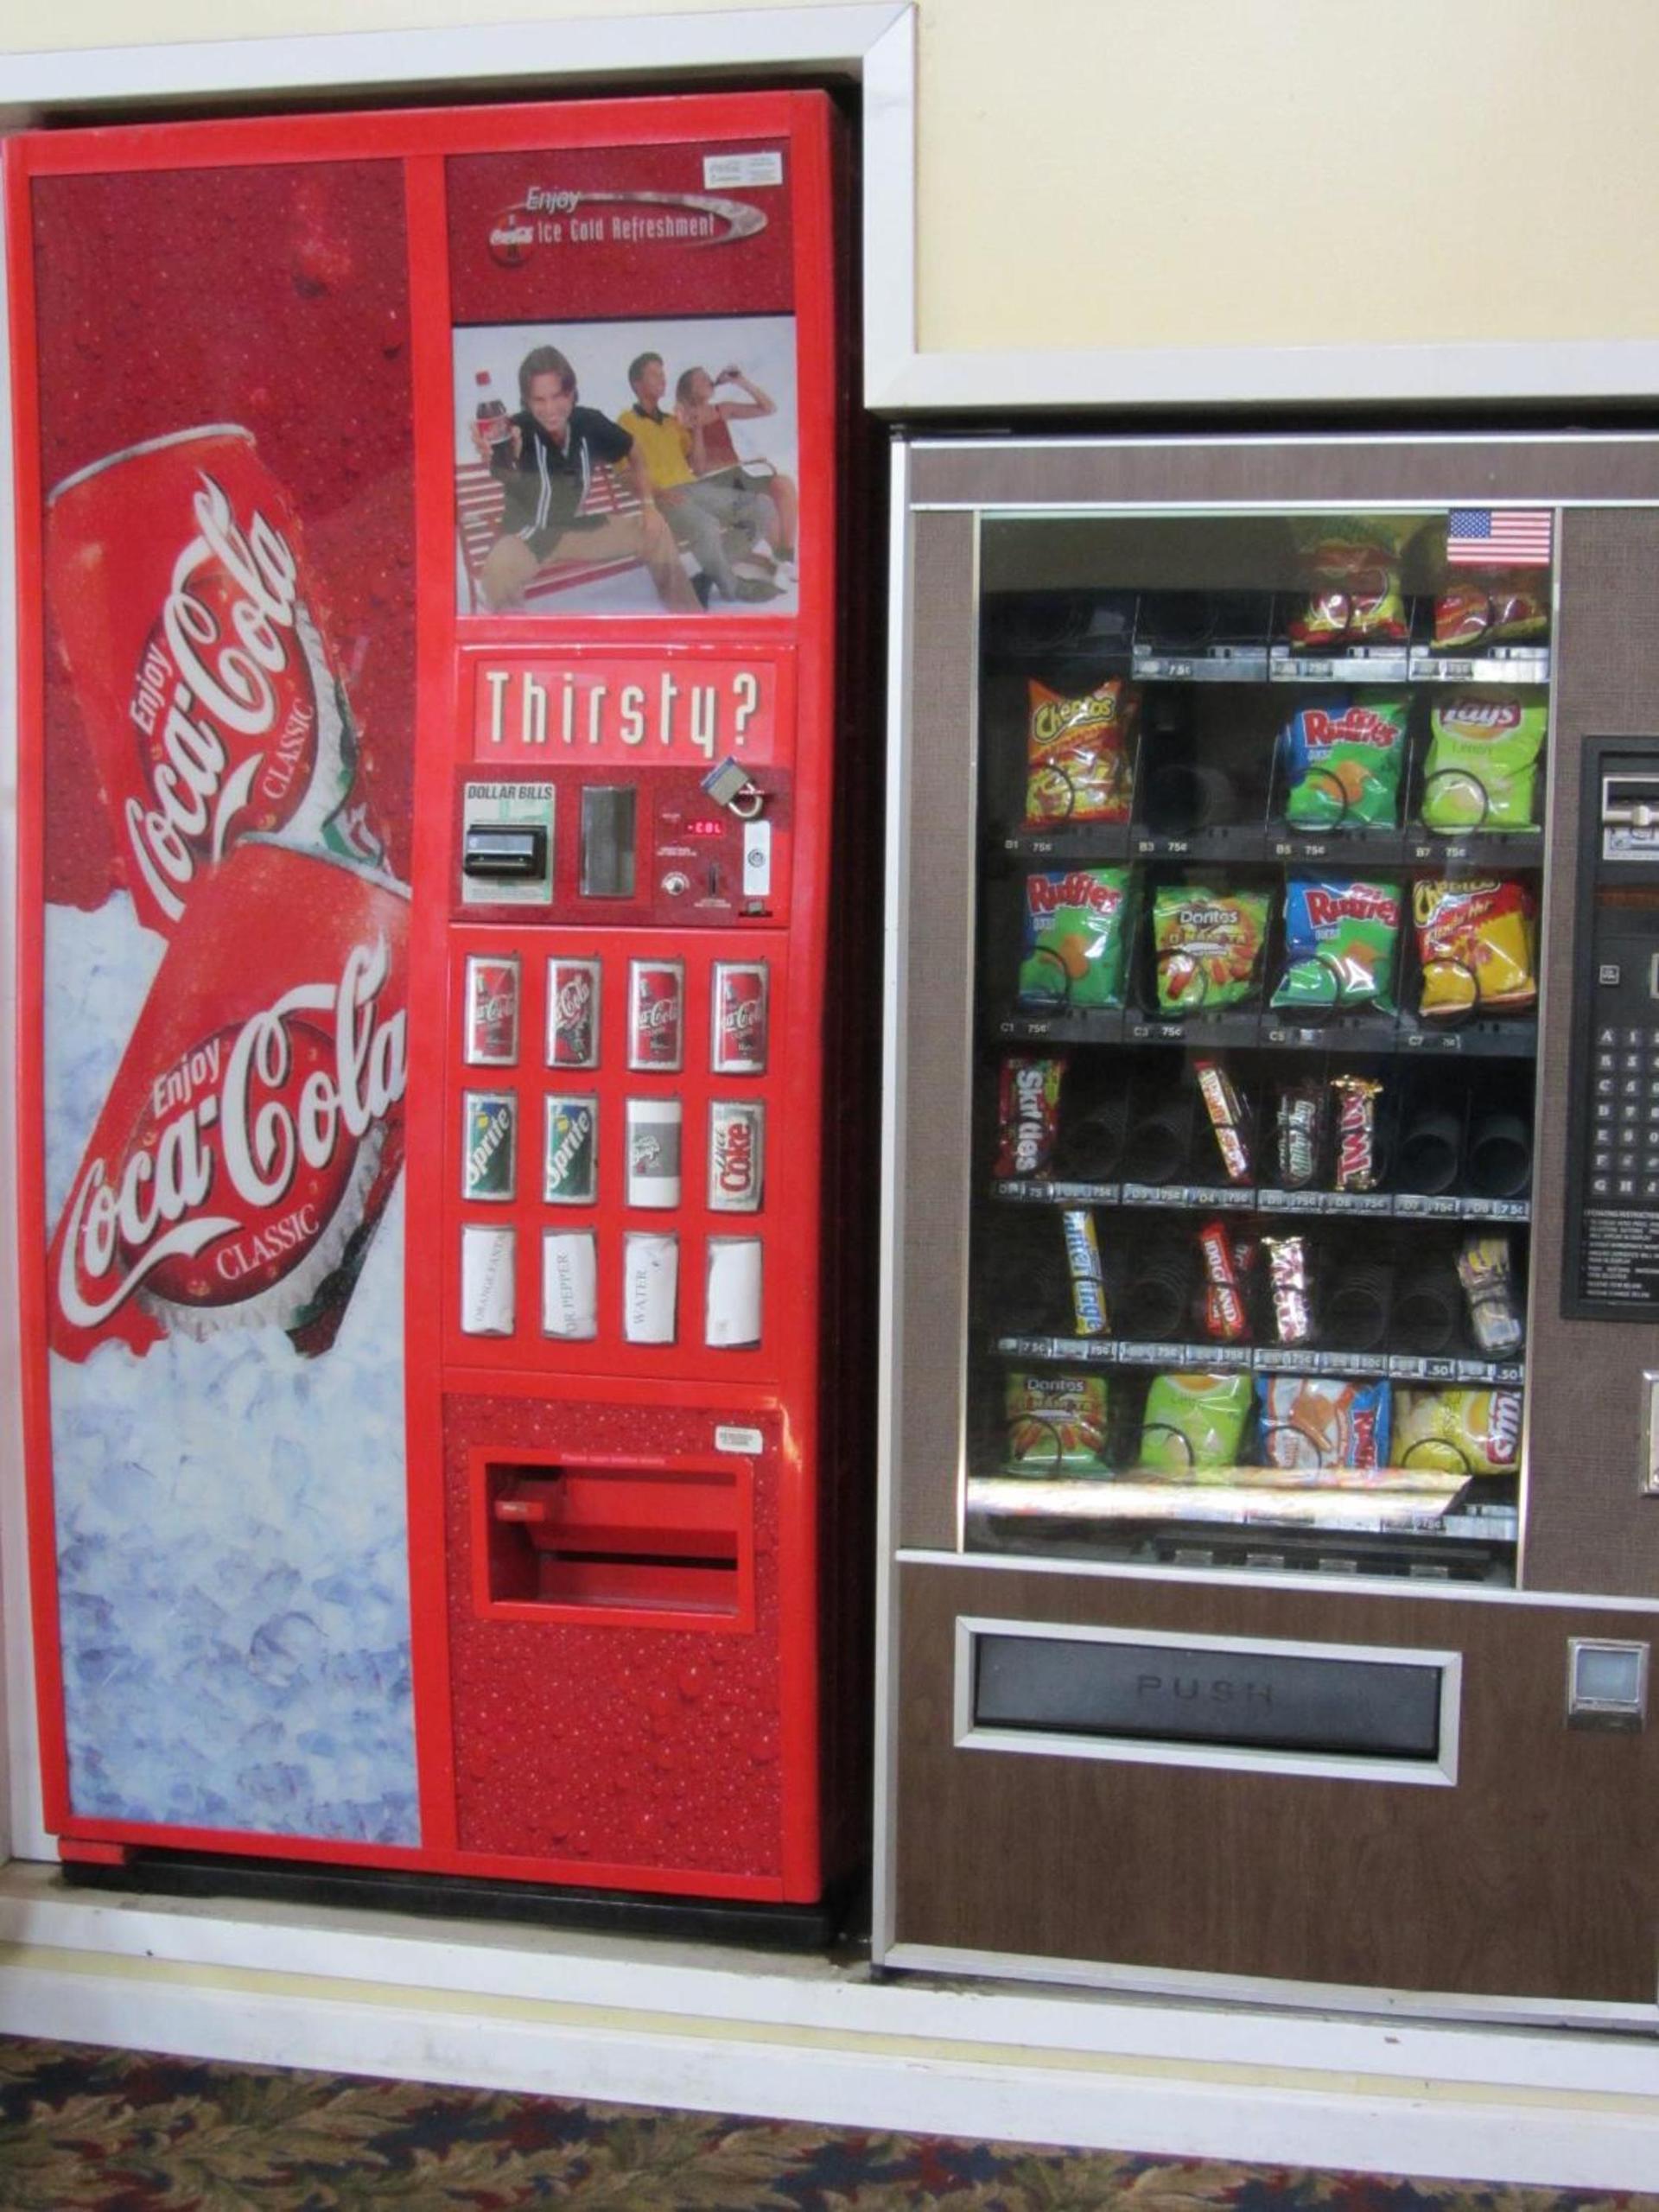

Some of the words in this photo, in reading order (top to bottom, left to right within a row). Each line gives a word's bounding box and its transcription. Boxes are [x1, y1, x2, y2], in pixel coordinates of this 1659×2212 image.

[526, 187, 580, 213] Enjoy
[539, 222, 562, 243] Ice
[570, 217, 604, 241] Cold
[613, 214, 715, 239] Refreshment
[125, 467, 298, 922] Coca-Cola
[130, 641, 174, 736] Enjoy
[486, 671, 758, 760] Thirsty?
[263, 698, 315, 800] CLASSIC
[467, 785, 516, 800] DOLLAR
[518, 785, 553, 800] BILLS
[1139, 842, 1154, 852] B3
[1027, 872, 1123, 915] Ruffles
[1179, 910, 1238, 924] Doritos
[152, 1038, 221, 1120] Enjoy
[58, 931, 407, 1328] Coca-Cola
[467, 1107, 511, 1187] Sprite
[548, 1110, 591, 1191] Sprite
[719, 1123, 752, 1193] Coke
[214, 1204, 320, 1281] CLASSIC
[557, 1252, 575, 1307] PEPPER
[632, 1269, 647, 1324] WATER
[1211, 1268, 1238, 1323] GAND
[1027, 1379, 1084, 1392] Doritos
[1427, 1363, 1448, 1376] .50
[1497, 1369, 1518, 1381] .50
[1136, 1675, 1272, 1704] PUSH
